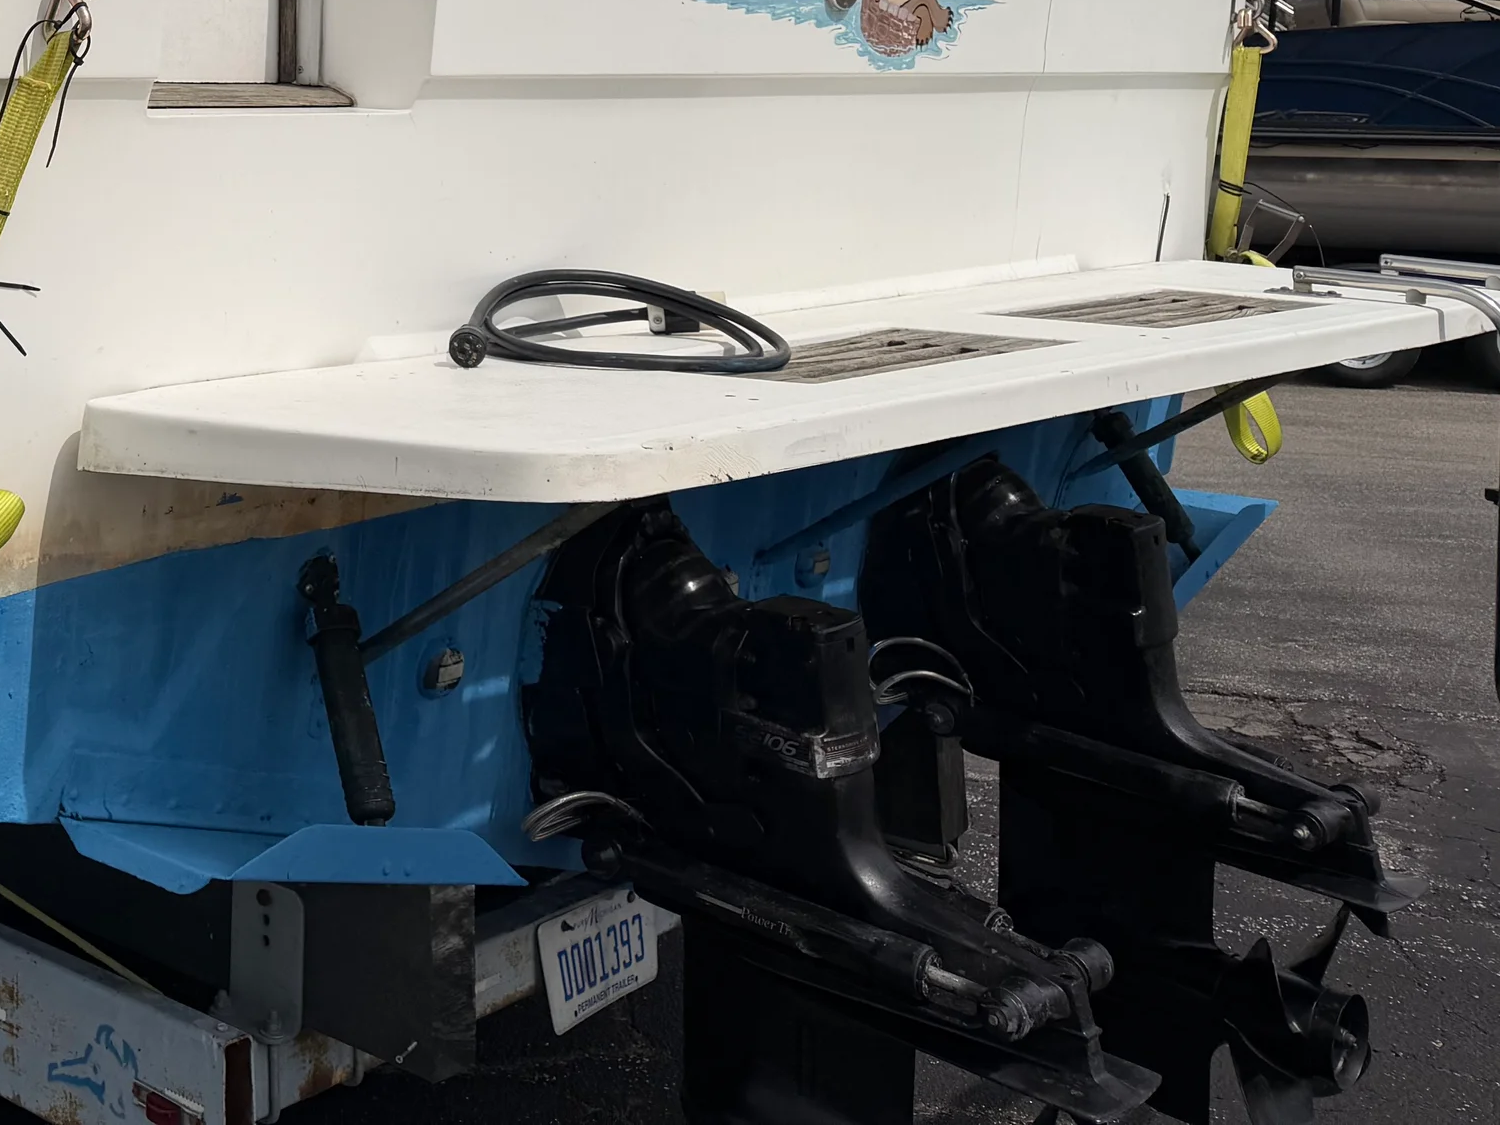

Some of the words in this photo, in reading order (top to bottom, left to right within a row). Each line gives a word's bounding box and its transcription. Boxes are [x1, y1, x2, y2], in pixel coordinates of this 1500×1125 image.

[741, 906, 777, 931] Power
[577, 986, 611, 1014] PERMANENT
[611, 974, 636, 995] TRAILER
